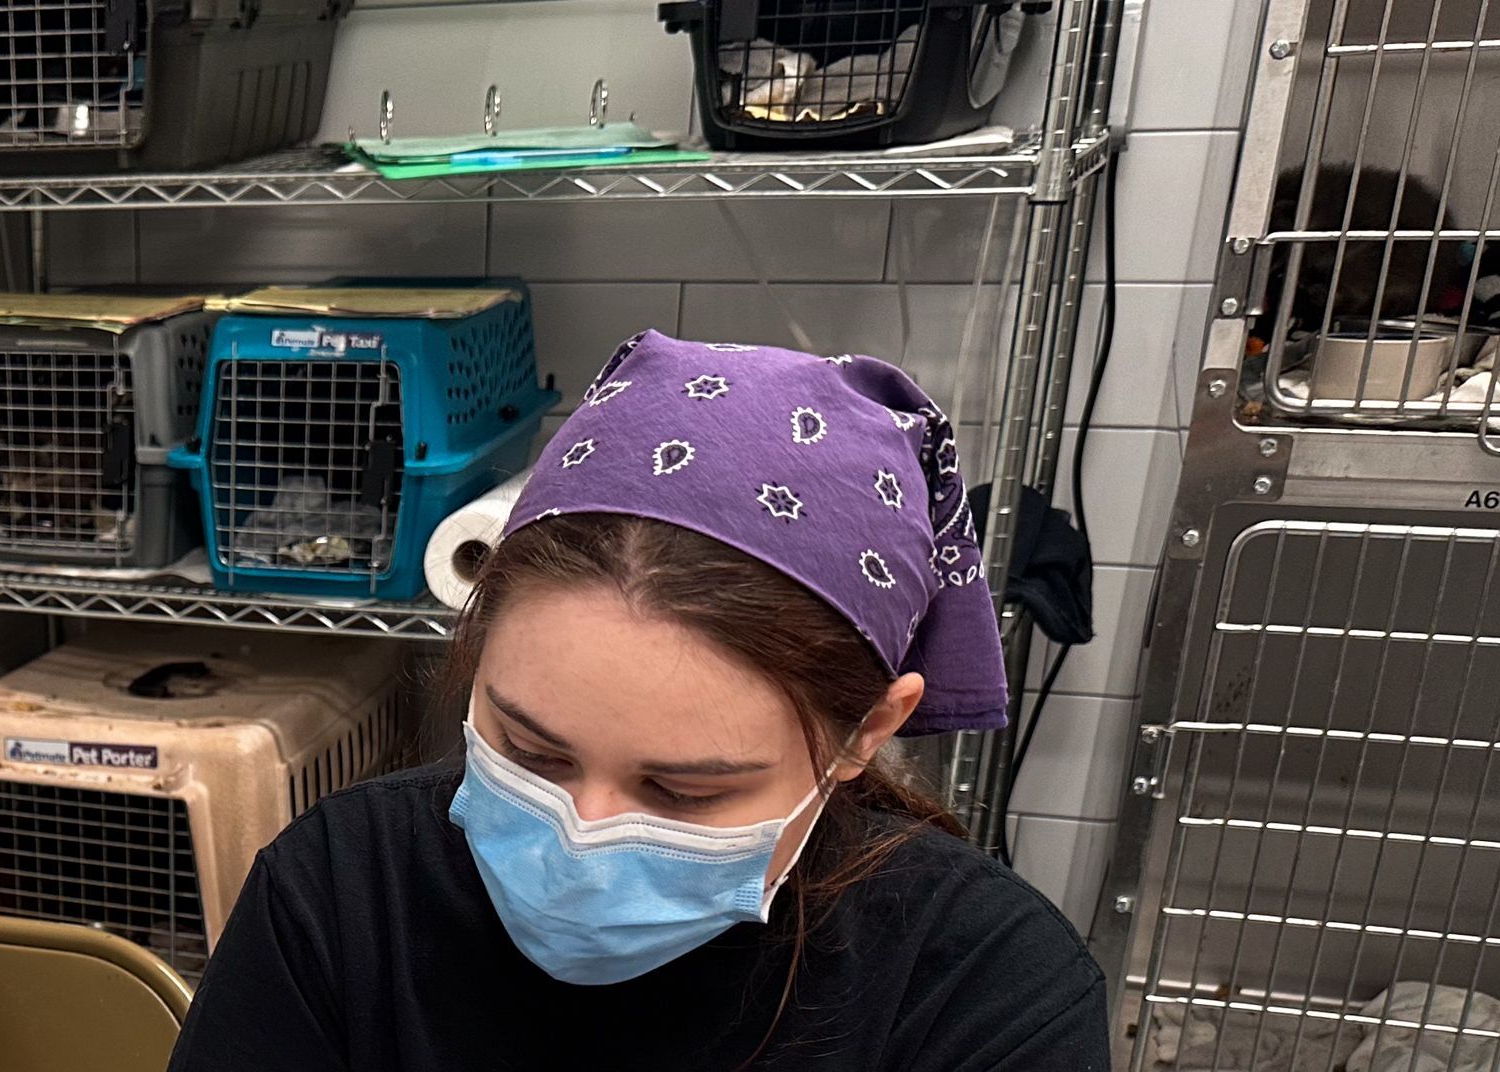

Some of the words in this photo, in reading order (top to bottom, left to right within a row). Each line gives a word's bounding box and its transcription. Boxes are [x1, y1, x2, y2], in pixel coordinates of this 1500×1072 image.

[1464, 489, 1500, 509] A6
[71, 747, 99, 765] Pet
[101, 749, 152, 767] Porter
